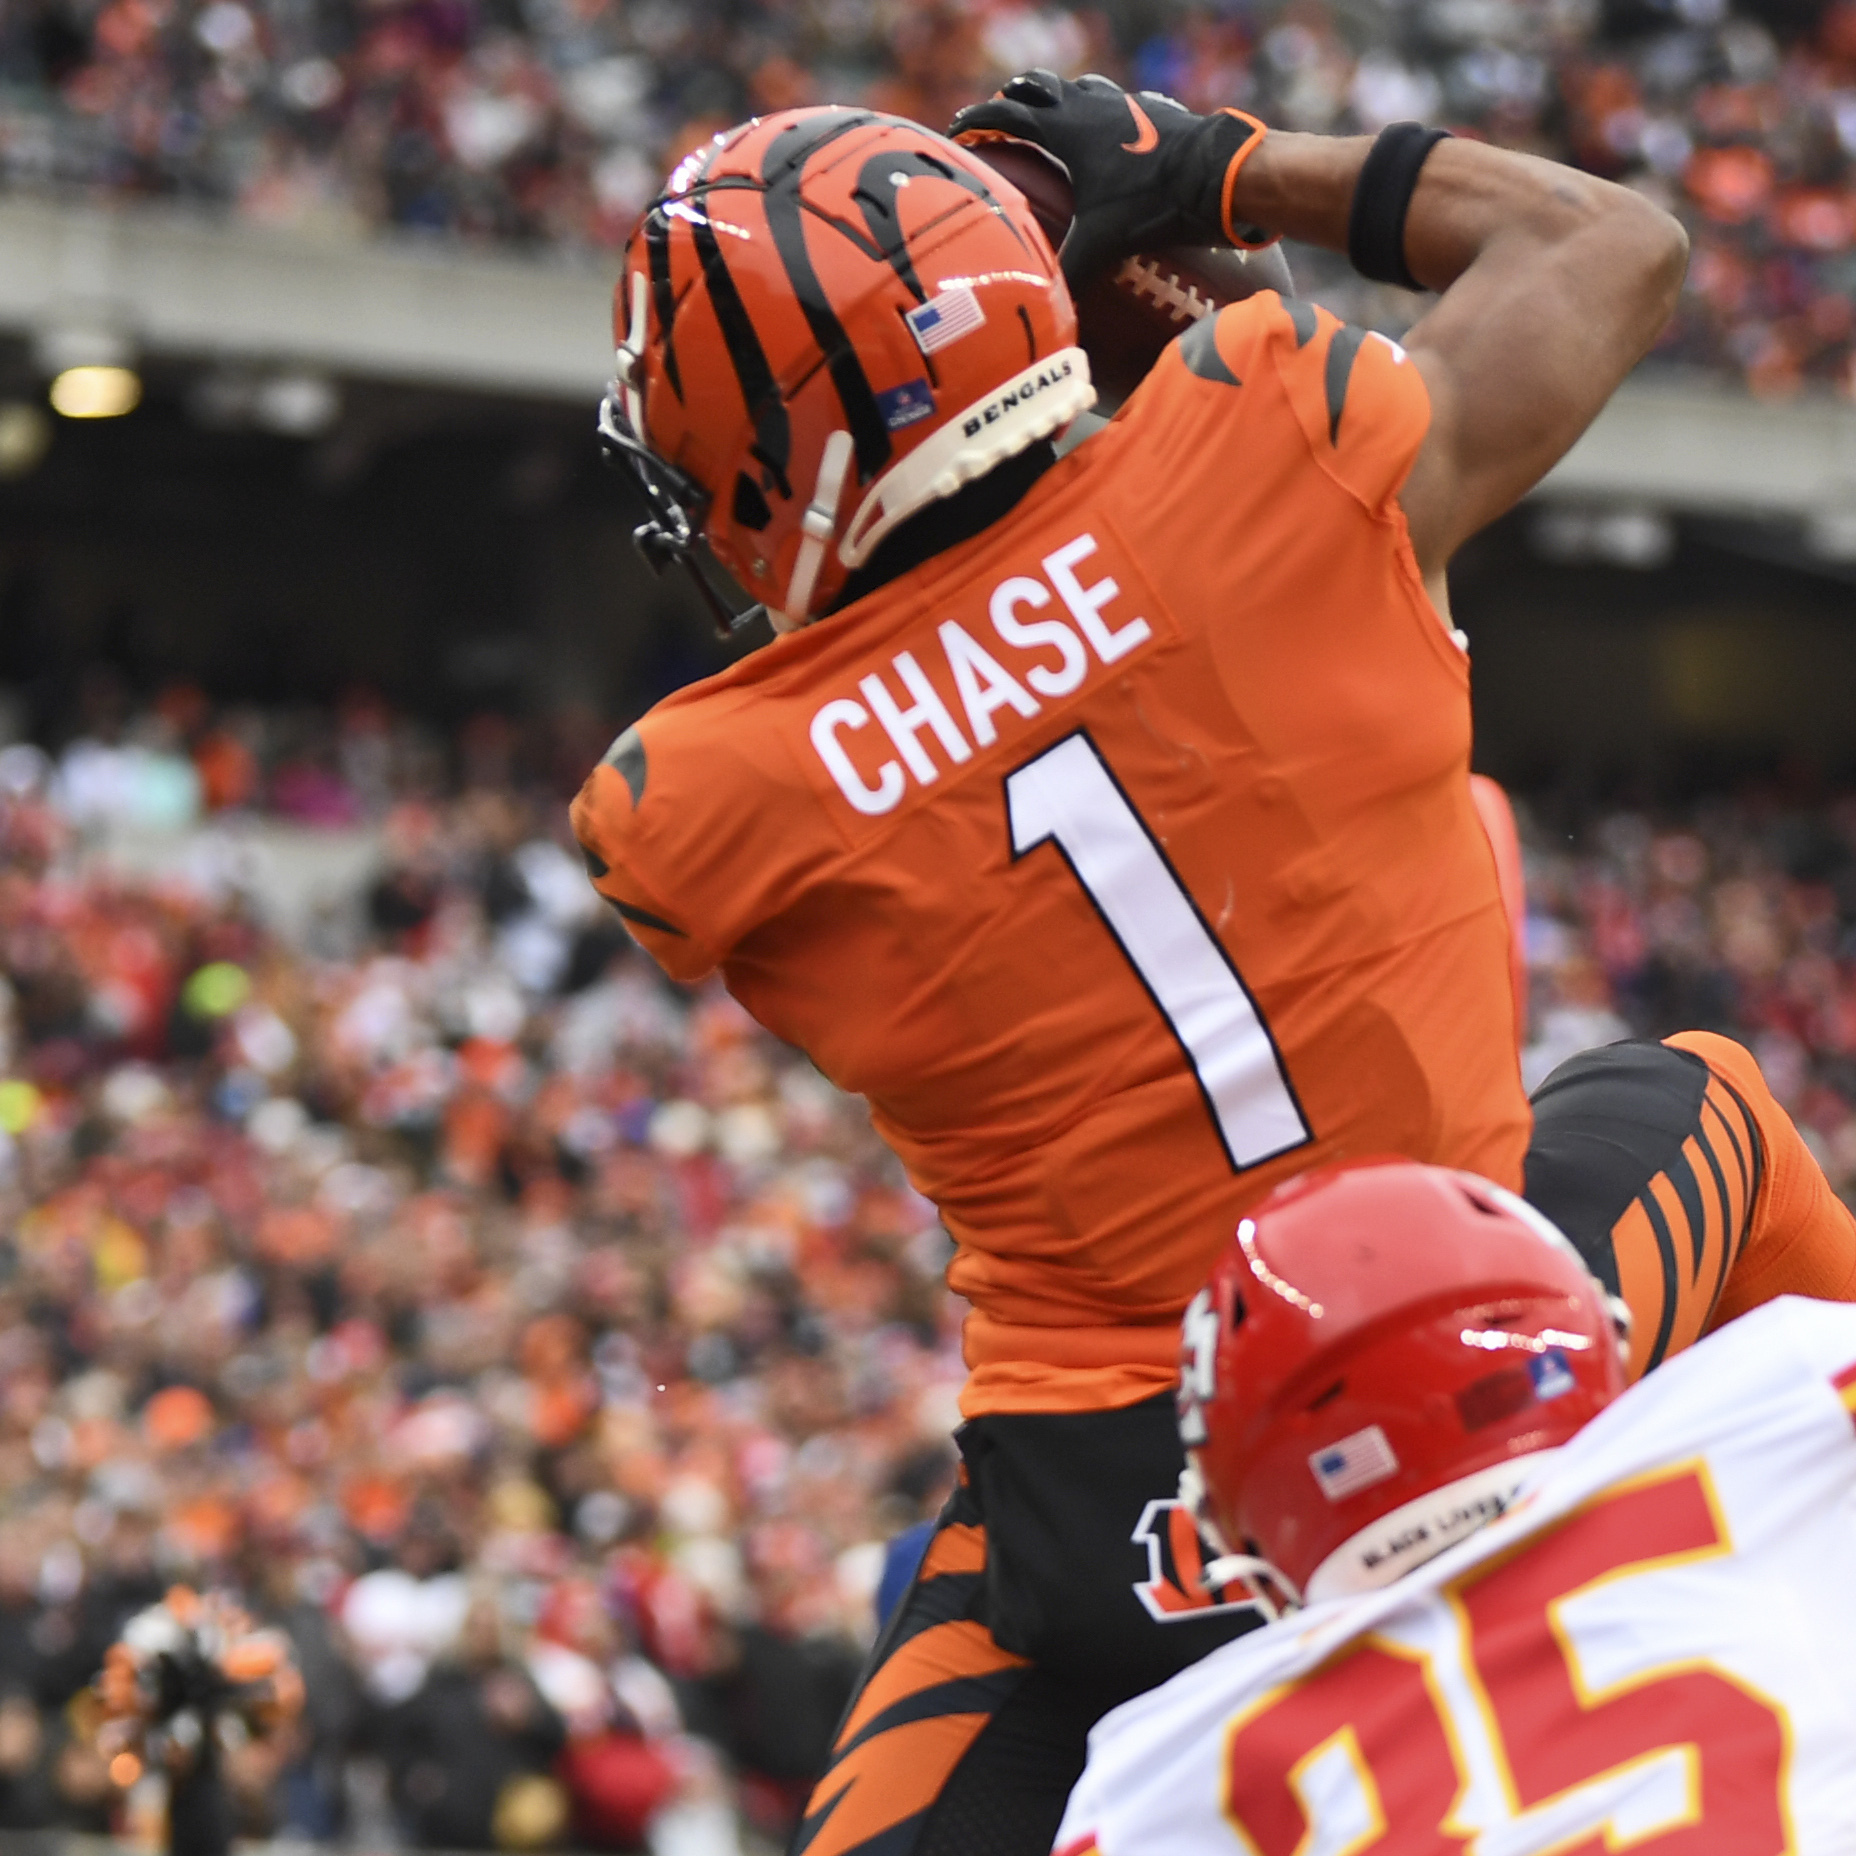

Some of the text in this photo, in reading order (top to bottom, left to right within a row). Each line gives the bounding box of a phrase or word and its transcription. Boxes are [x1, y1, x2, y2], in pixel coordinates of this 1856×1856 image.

[961, 359, 1073, 438] BENGALS
[808, 533, 1153, 817] CHASE
[1004, 728, 1313, 1170] 1
